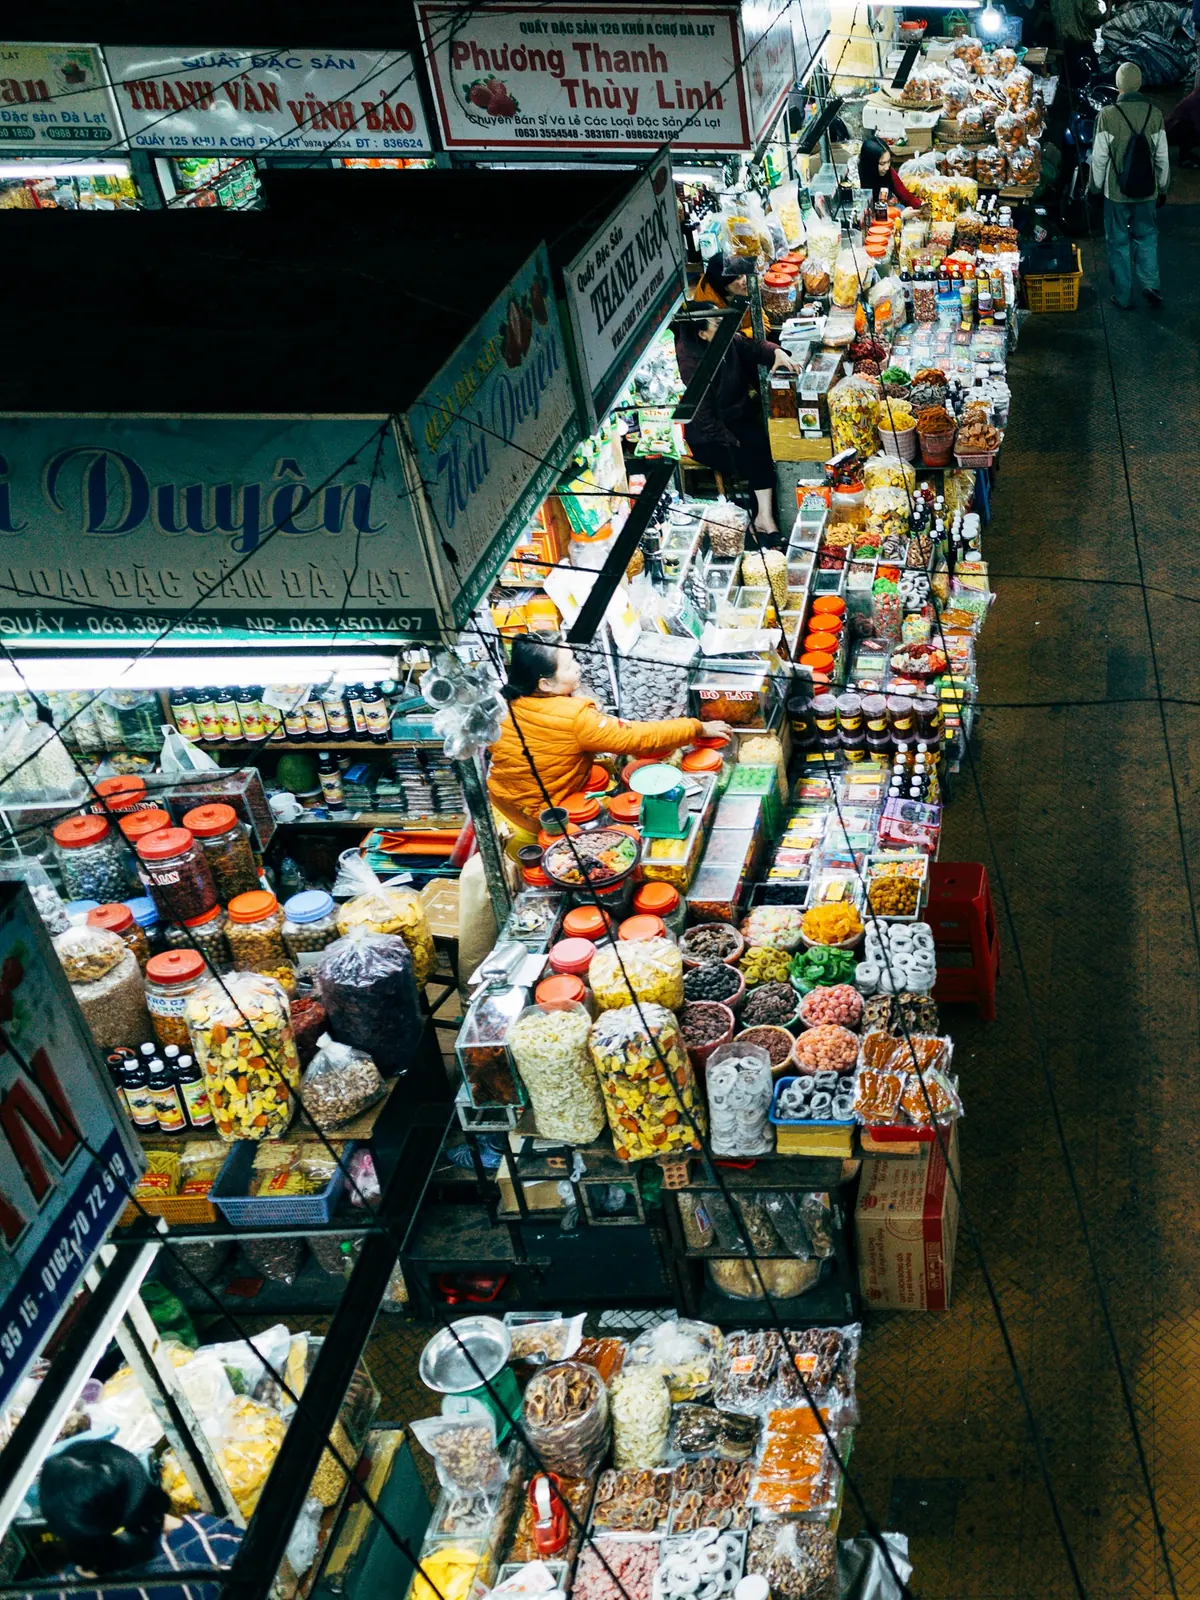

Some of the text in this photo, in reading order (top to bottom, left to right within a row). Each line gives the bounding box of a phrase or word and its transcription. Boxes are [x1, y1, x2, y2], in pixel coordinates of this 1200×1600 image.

[600, 22, 620, 35] 126
[310, 54, 356, 70] SẢN
[451, 40, 668, 78] Phương Thanh
[122, 72, 284, 112] THANH VÂN
[560, 78, 639, 115] Thùy
[655, 80, 724, 111] Linh
[286, 90, 415, 133] VĨNH BẢO
[169, 136, 188, 146] 125
[219, 136, 228, 146] A
[383, 138, 424, 149] 836624
[589, 239, 639, 336] THANH
[41, 445, 389, 554] Duyên
[105, 562, 183, 606] ĐẶC
[281, 561, 336, 600] ĐÀ
[342, 568, 412, 607] LẠT
[84, 1180, 107, 1216] 72
